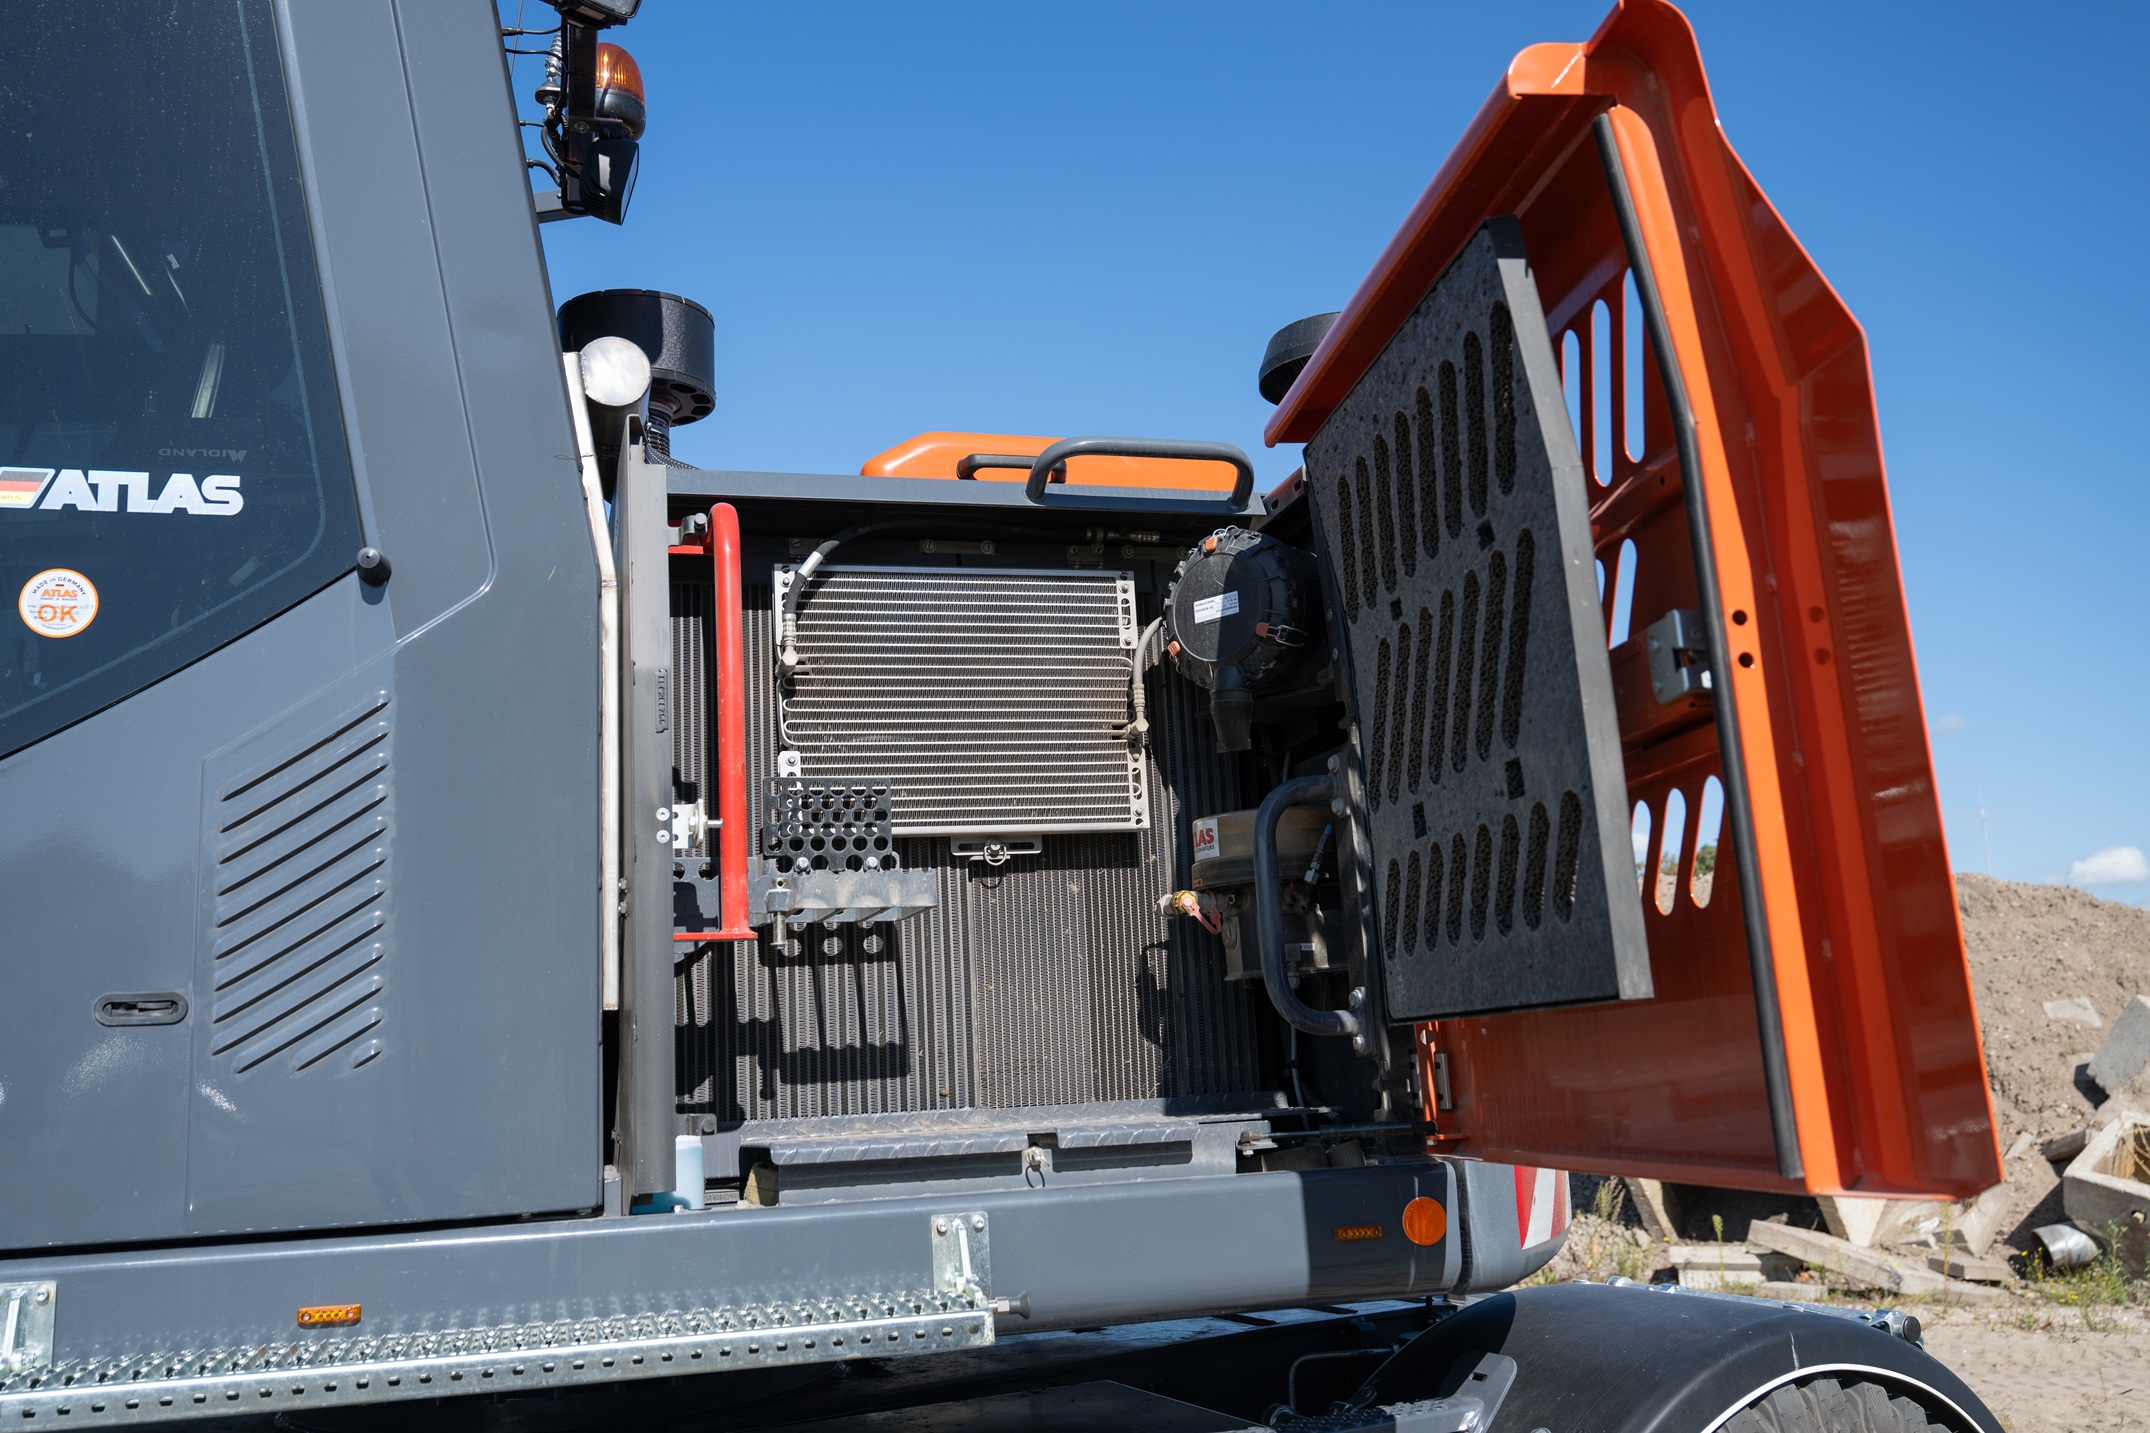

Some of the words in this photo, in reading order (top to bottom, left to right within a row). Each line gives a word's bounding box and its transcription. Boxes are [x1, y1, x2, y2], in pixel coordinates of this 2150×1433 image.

[158, 447, 248, 463] MIDLAND
[38, 468, 244, 516] ATLAS
[32, 580, 48, 594] MADE
[57, 576, 87, 595] GERMANY
[41, 589, 78, 598] ATLAS
[37, 603, 77, 623] OK
[1193, 828, 1214, 848] LAS
